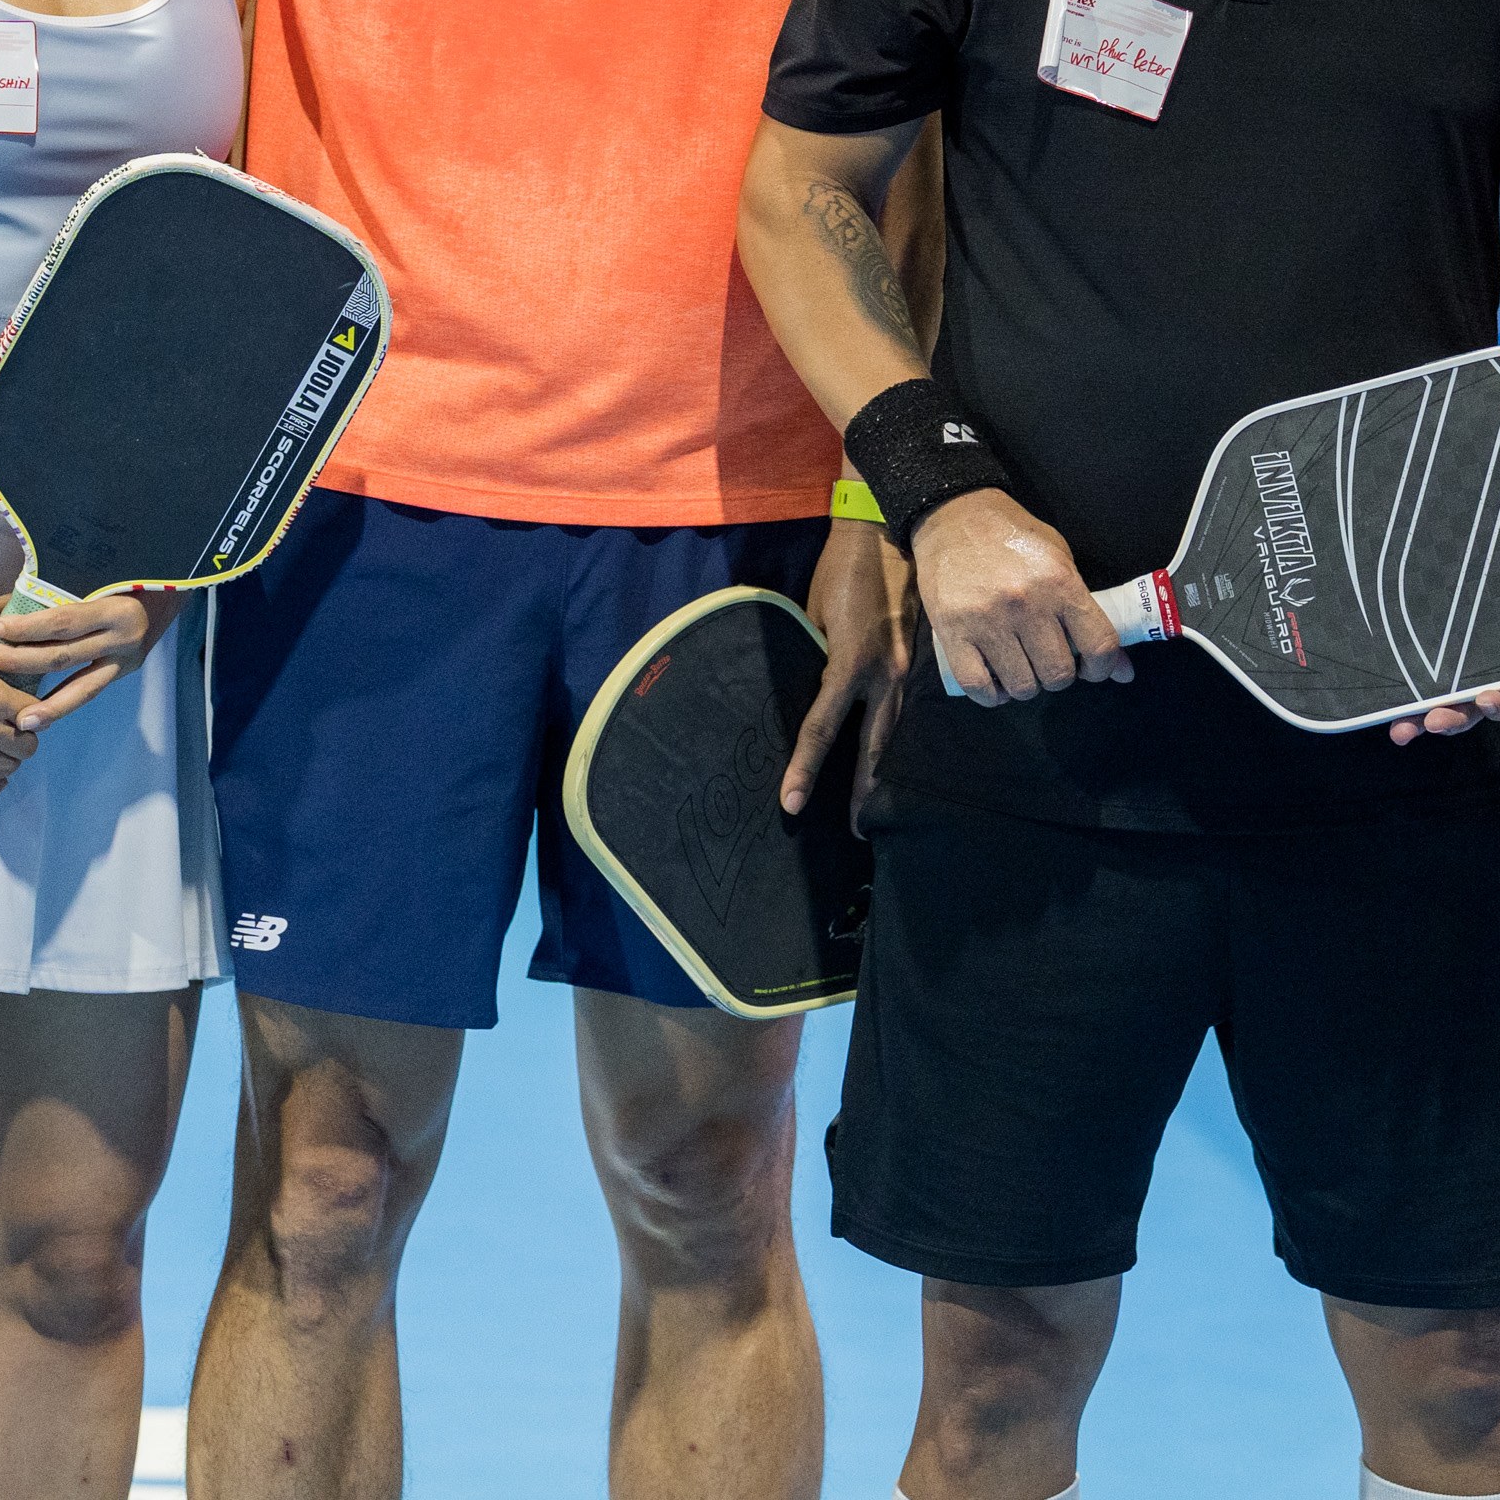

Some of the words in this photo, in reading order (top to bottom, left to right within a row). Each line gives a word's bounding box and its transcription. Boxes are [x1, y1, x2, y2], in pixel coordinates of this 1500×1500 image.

[295, 348, 346, 414] JOOLA
[288, 414, 308, 428] PRO
[219, 435, 294, 556] SCORPEUS
[1253, 525, 1293, 654] VANGUARD
[1286, 611, 1307, 667] PRO
